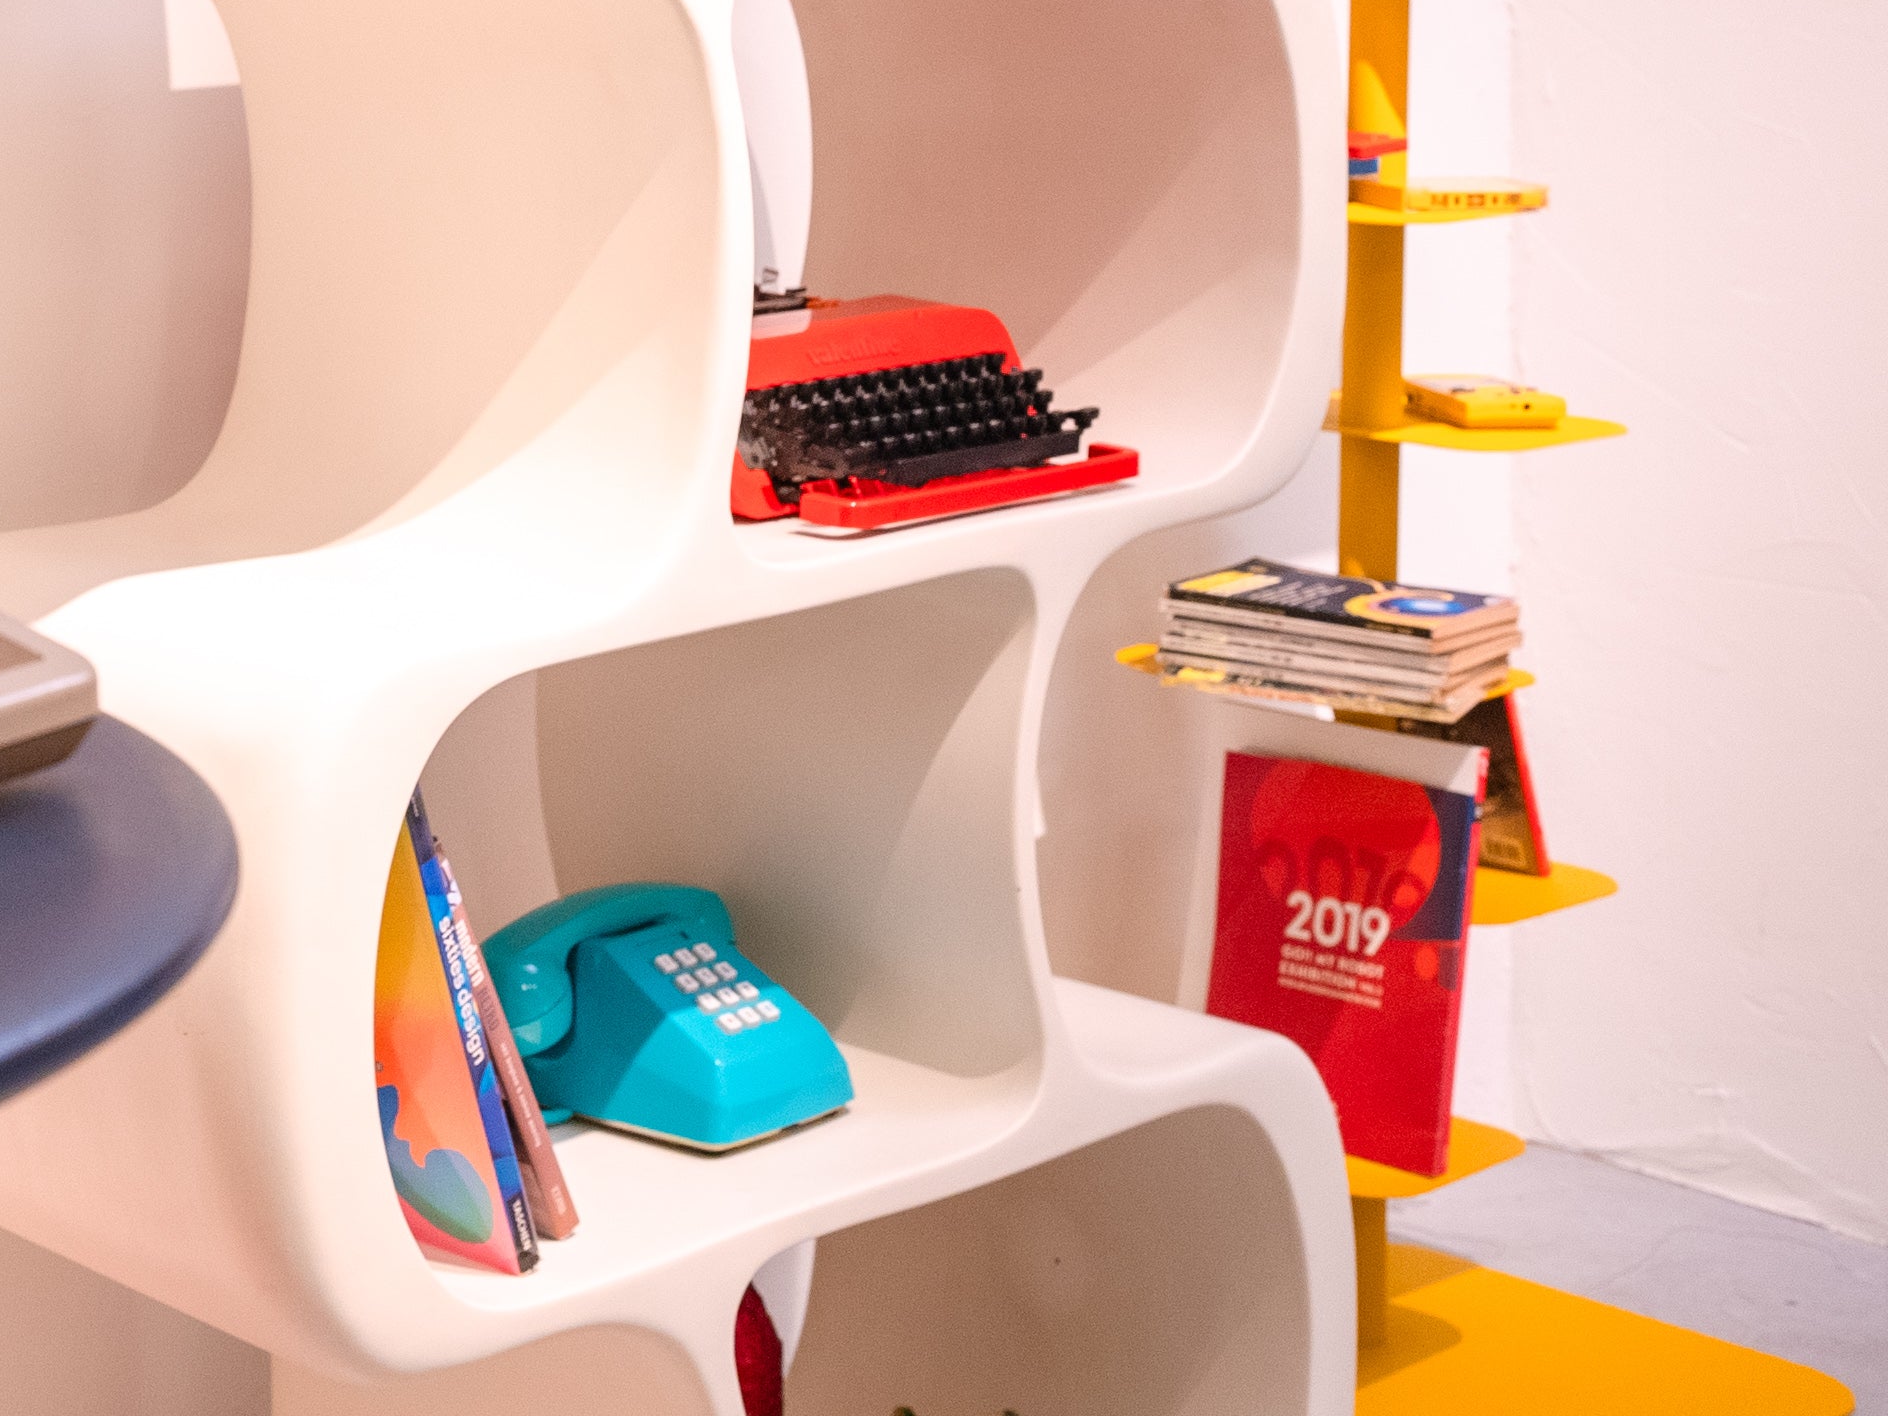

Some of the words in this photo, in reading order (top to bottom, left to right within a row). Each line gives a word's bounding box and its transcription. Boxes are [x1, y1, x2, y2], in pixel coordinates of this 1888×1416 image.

[454, 919, 485, 988] modern
[1284, 889, 1391, 957] 2019
[439, 915, 466, 990] sixties
[457, 988, 486, 1065] design
